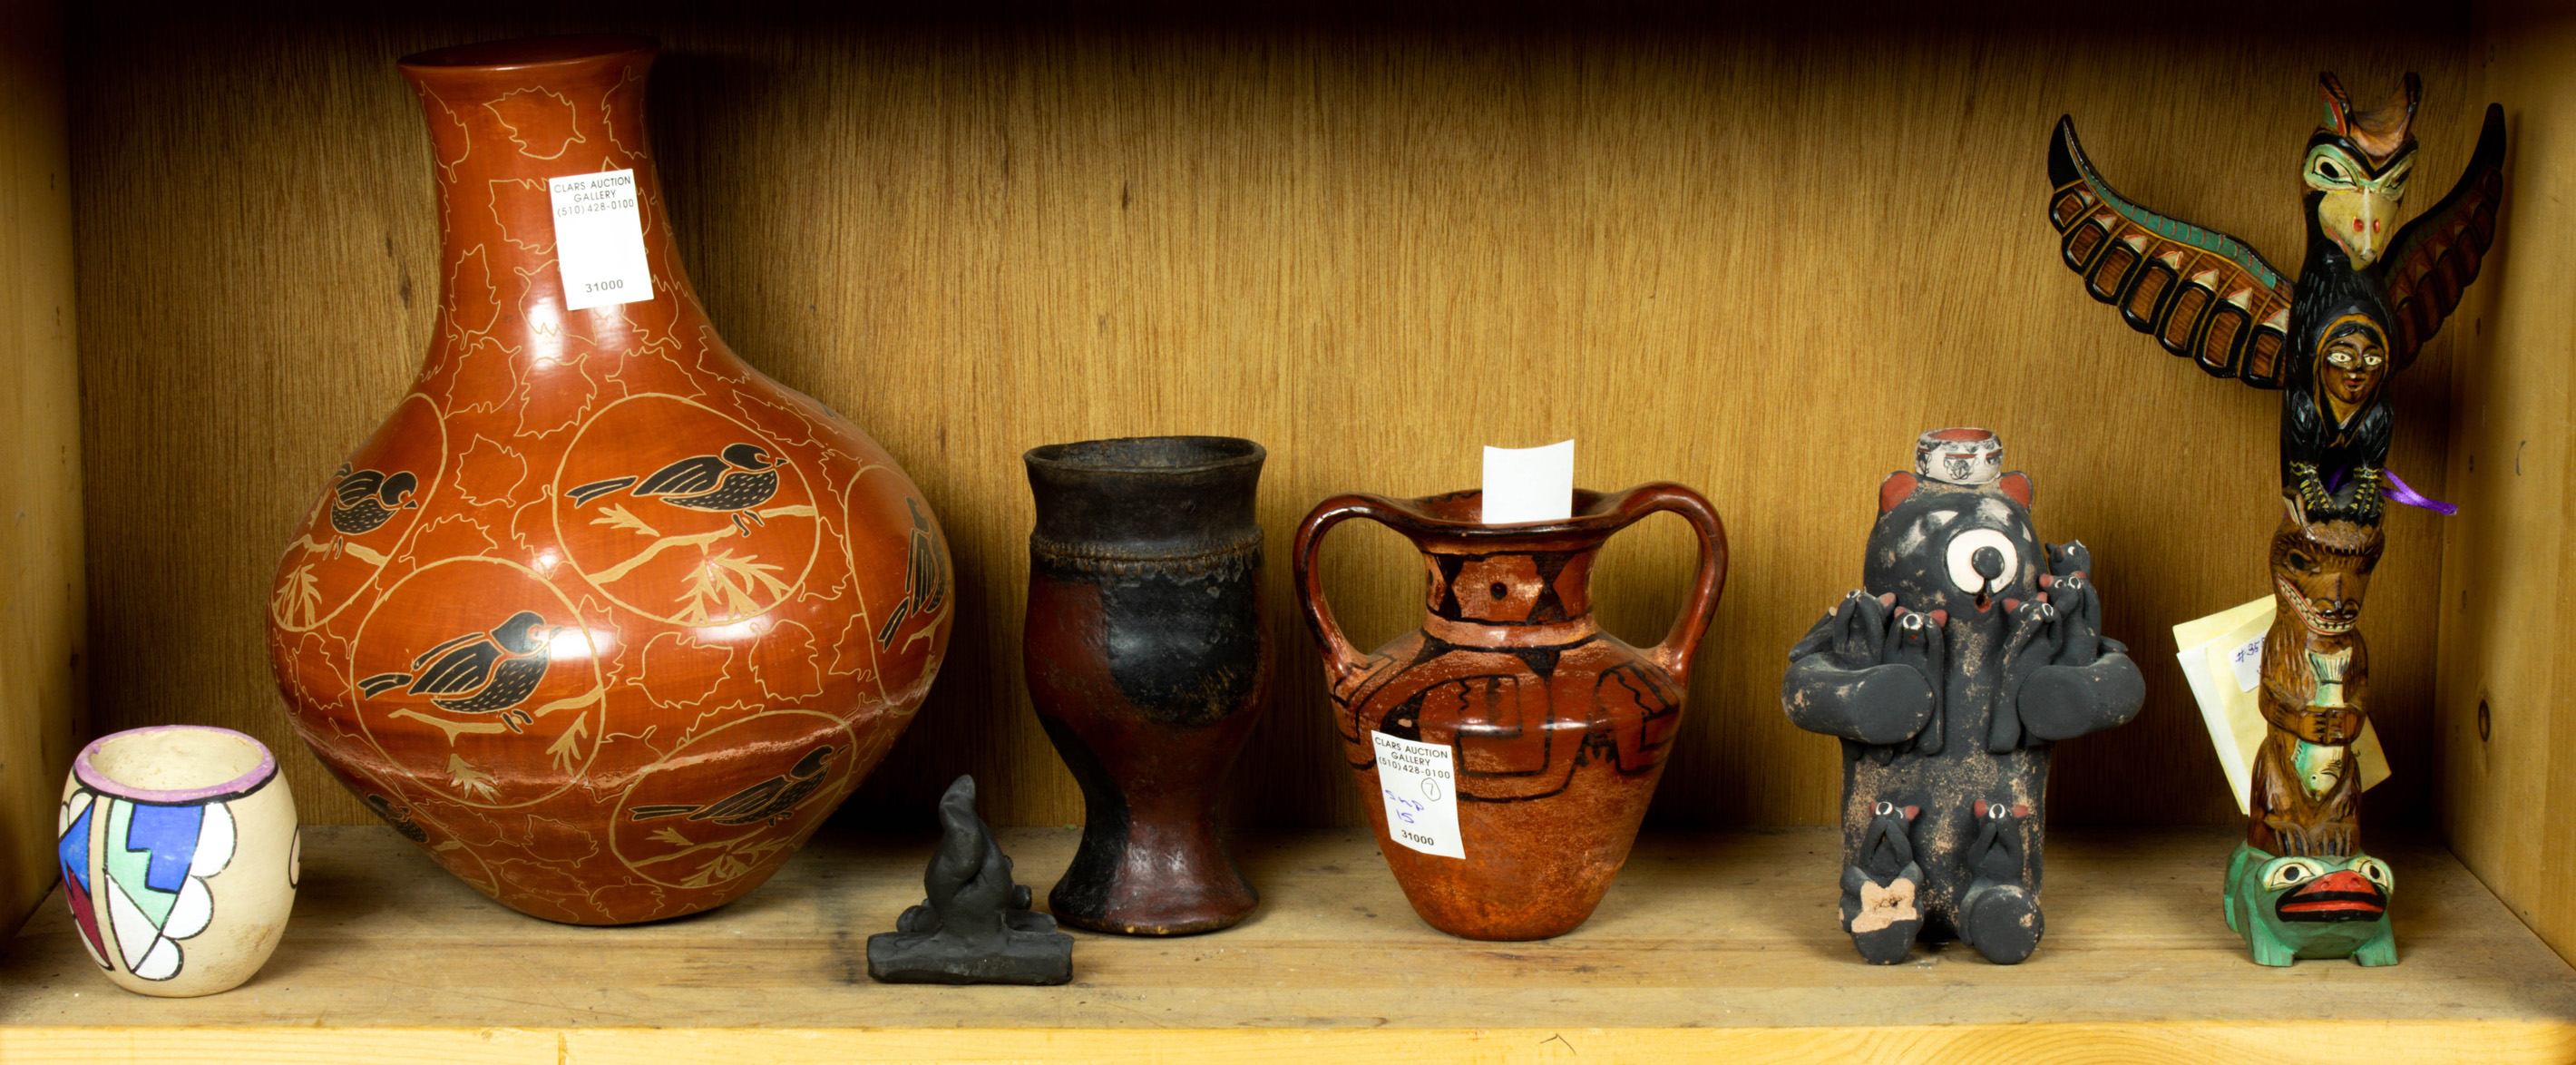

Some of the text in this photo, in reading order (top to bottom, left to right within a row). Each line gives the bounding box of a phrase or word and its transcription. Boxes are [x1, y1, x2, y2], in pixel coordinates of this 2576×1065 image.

[554, 175, 631, 193] CLARS AUCTION
[573, 190, 617, 202] GALLERY
[585, 278, 624, 293] 31000
[1374, 737, 1448, 759] CLARS AUCTION
[1390, 751, 1430, 766] GALLERY
[1401, 829, 1435, 846] 31000
